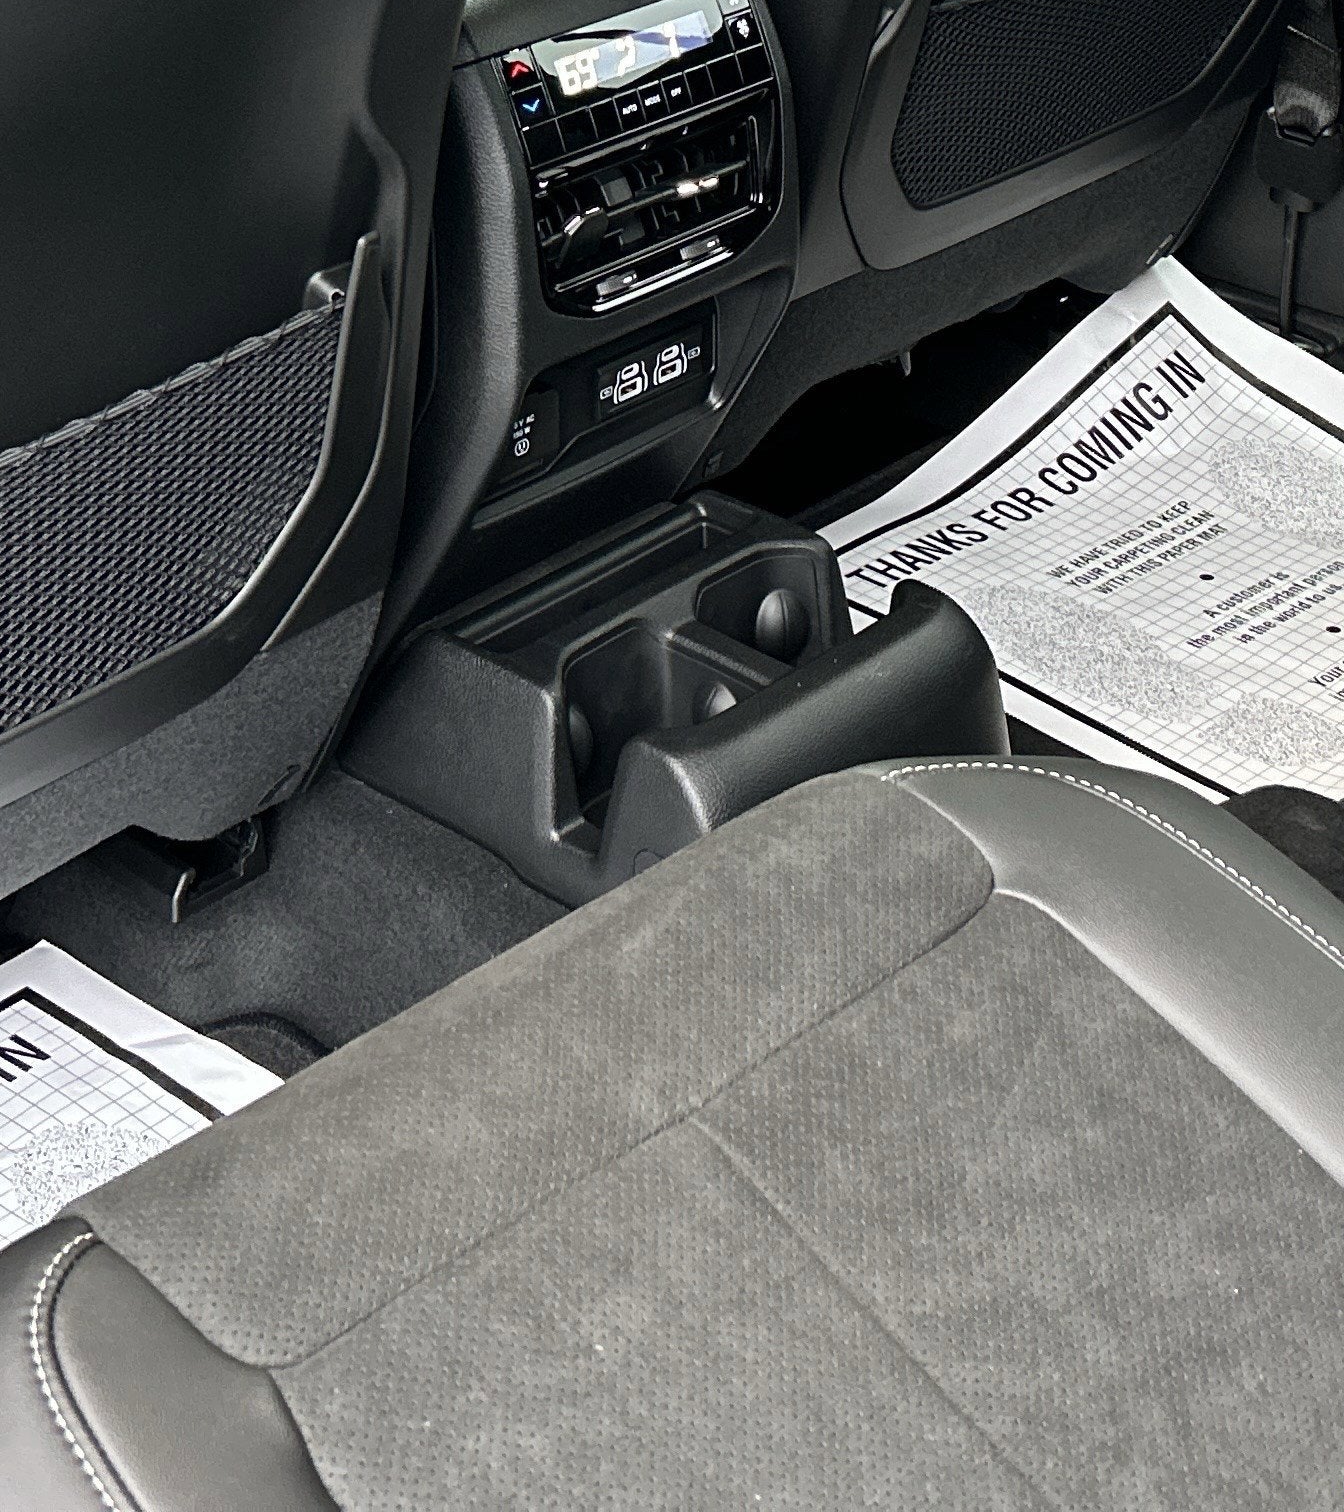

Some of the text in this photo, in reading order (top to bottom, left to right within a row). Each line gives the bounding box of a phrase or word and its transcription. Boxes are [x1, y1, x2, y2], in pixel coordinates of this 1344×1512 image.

[622, 103, 638, 115] AUTO
[845, 349, 1206, 588] THANKS FOR COMING IN
[1047, 500, 1192, 579] WE HAVE TRIED TO KEEP
[1065, 509, 1215, 589] YOUR CARPETING CLEAN
[1093, 523, 1229, 595] WITH THIS PAPER MAT
[1187, 634, 1215, 649] the
[1212, 613, 1249, 636] most
[1241, 582, 1306, 617] important
[1203, 608, 1221, 619] A
[1216, 578, 1275, 612] customer
[1248, 620, 1277, 635] the
[1273, 600, 1312, 622] world
[1305, 593, 1326, 605] to
